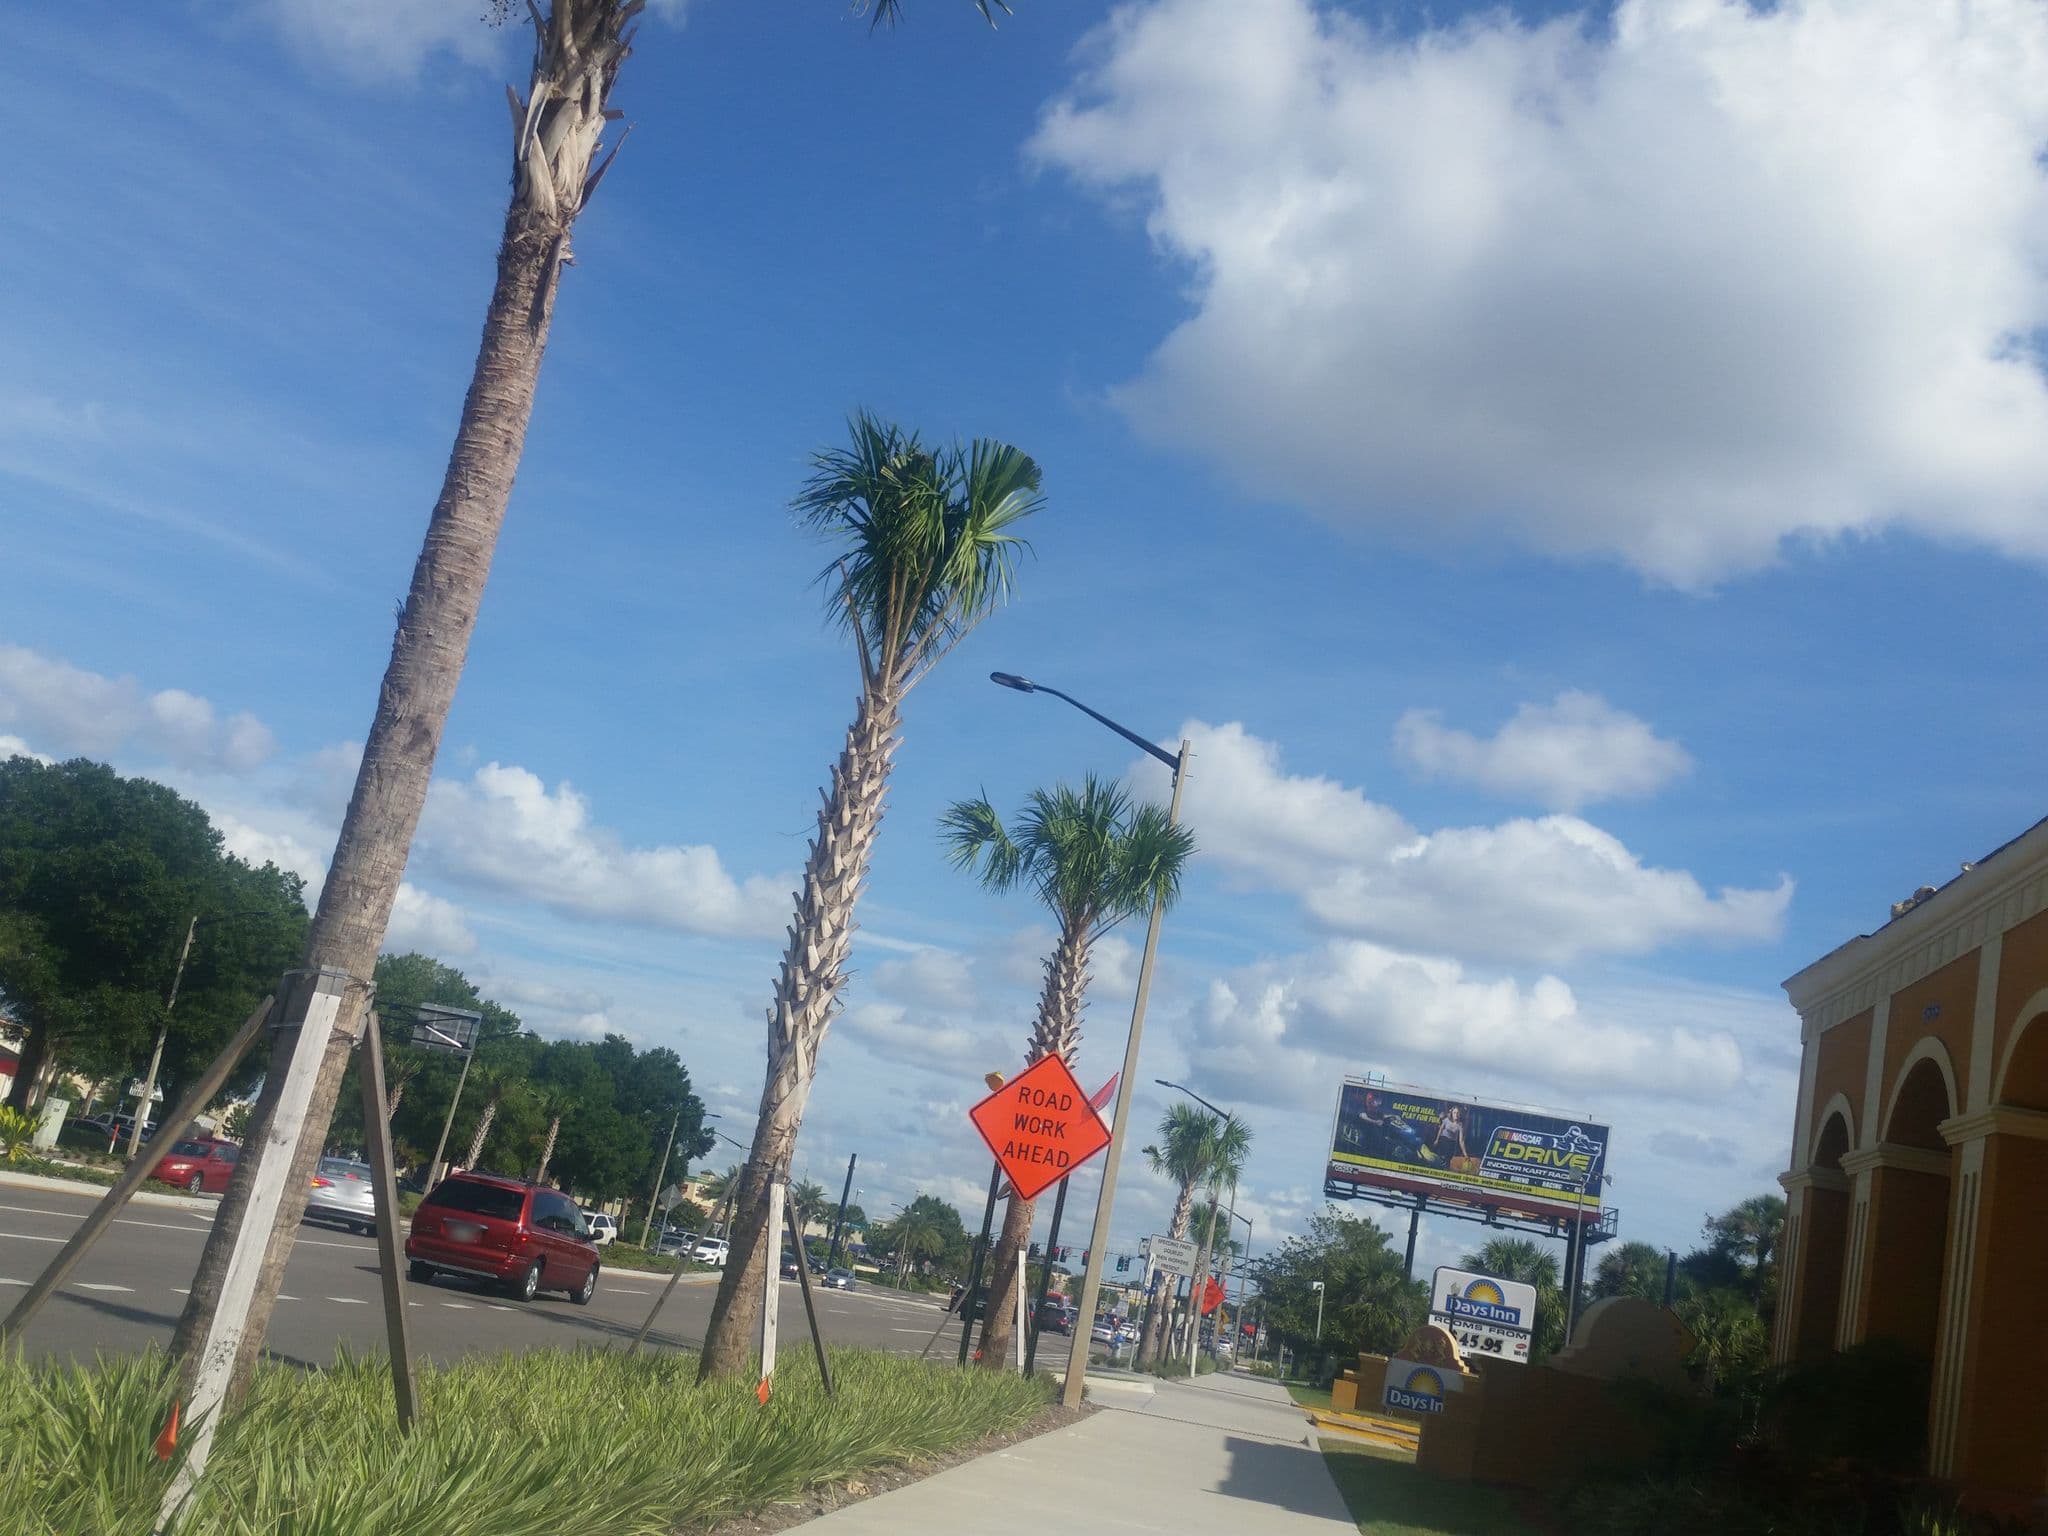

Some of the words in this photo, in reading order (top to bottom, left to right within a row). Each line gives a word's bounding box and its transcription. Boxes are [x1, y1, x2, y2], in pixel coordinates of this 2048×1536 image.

[1018, 1086, 1073, 1112] ROAD
[1014, 1113, 1068, 1139] WORK
[1511, 1131, 1543, 1145] NASCAR
[1003, 1140, 1070, 1168] AHEAD
[1490, 1140, 1591, 1171] I-DRIVE
[1486, 1161, 1521, 1172] INDOOR
[1522, 1164, 1547, 1176] KART
[1547, 1169, 1585, 1183] RACI
[1449, 1298, 1488, 1316] Days
[1489, 1306, 1516, 1322] Inn
[1433, 1315, 1483, 1331] ROOMS
[1488, 1327, 1528, 1341] FROM
[1390, 1390, 1428, 1410] Days
[1430, 1398, 1445, 1412] In
